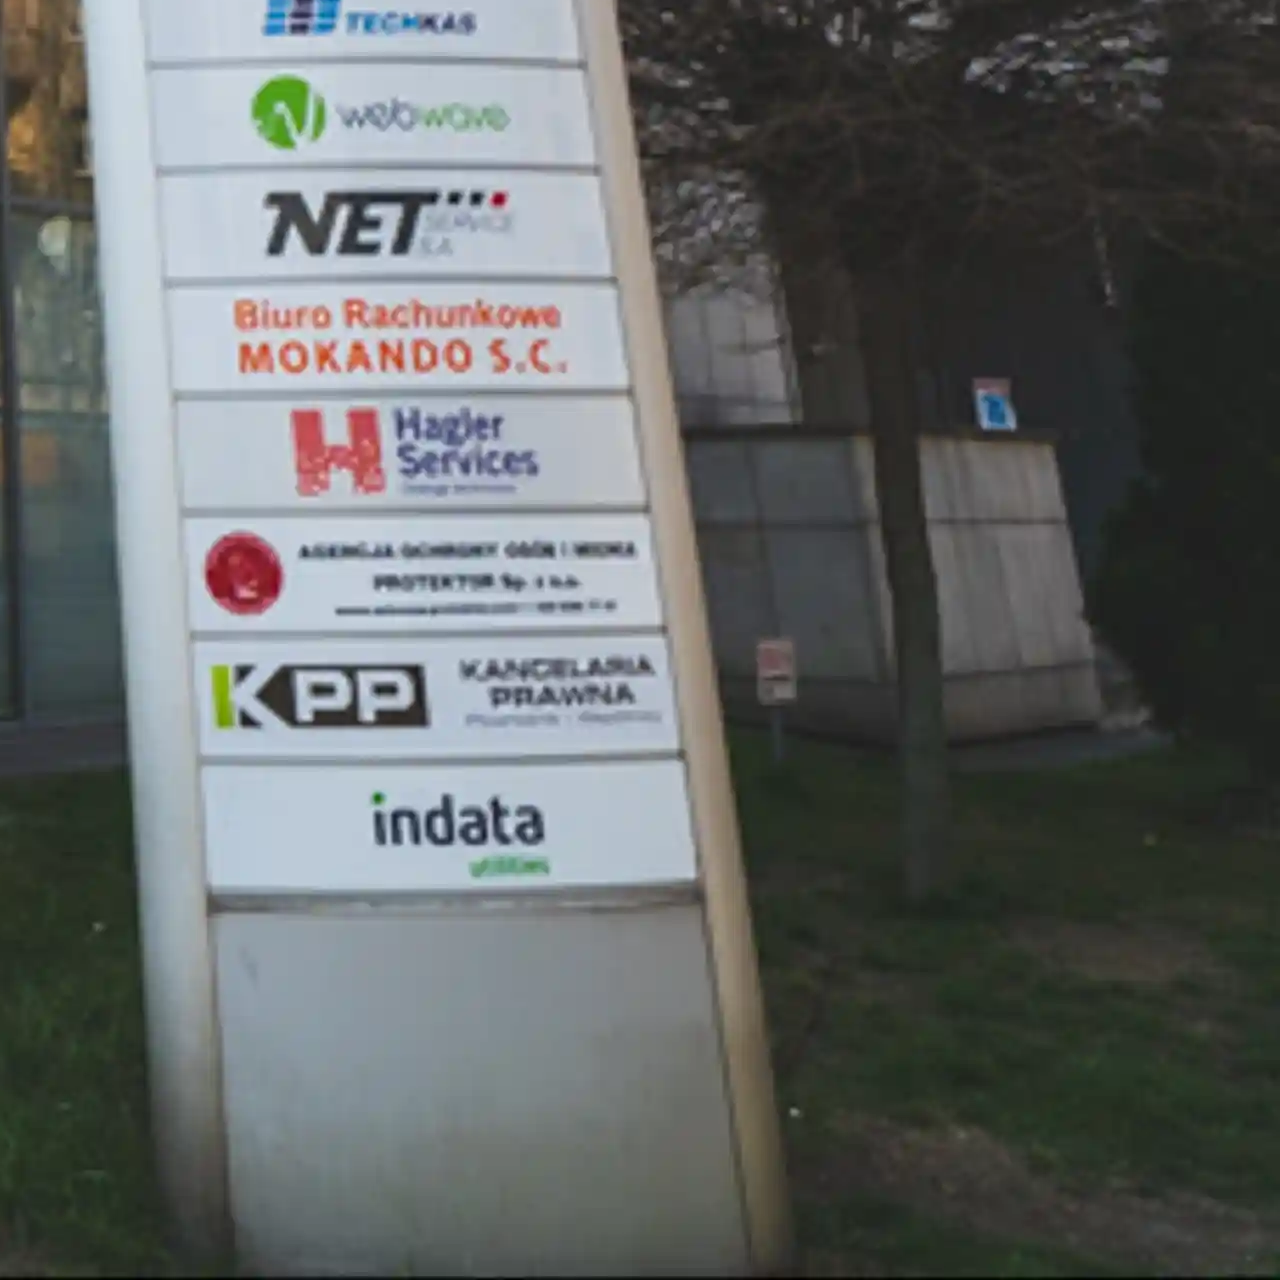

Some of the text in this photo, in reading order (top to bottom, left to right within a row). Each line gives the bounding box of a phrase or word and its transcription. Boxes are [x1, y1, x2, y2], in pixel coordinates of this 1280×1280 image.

[345, 11, 477, 36] TECHKAS
[335, 96, 511, 133] webwave
[264, 192, 439, 255] NET
[234, 297, 562, 330] Biuro Rachunkowe
[238, 338, 568, 375] MOKANDO S.C.
[394, 405, 505, 446] Hagler
[397, 443, 539, 480] Services
[373, 574, 495, 592] PROTEKTOR
[459, 655, 656, 681] KANCELARIA
[210, 663, 420, 729] KPP
[489, 683, 636, 707] PRAWNA
[371, 791, 545, 847] indata
